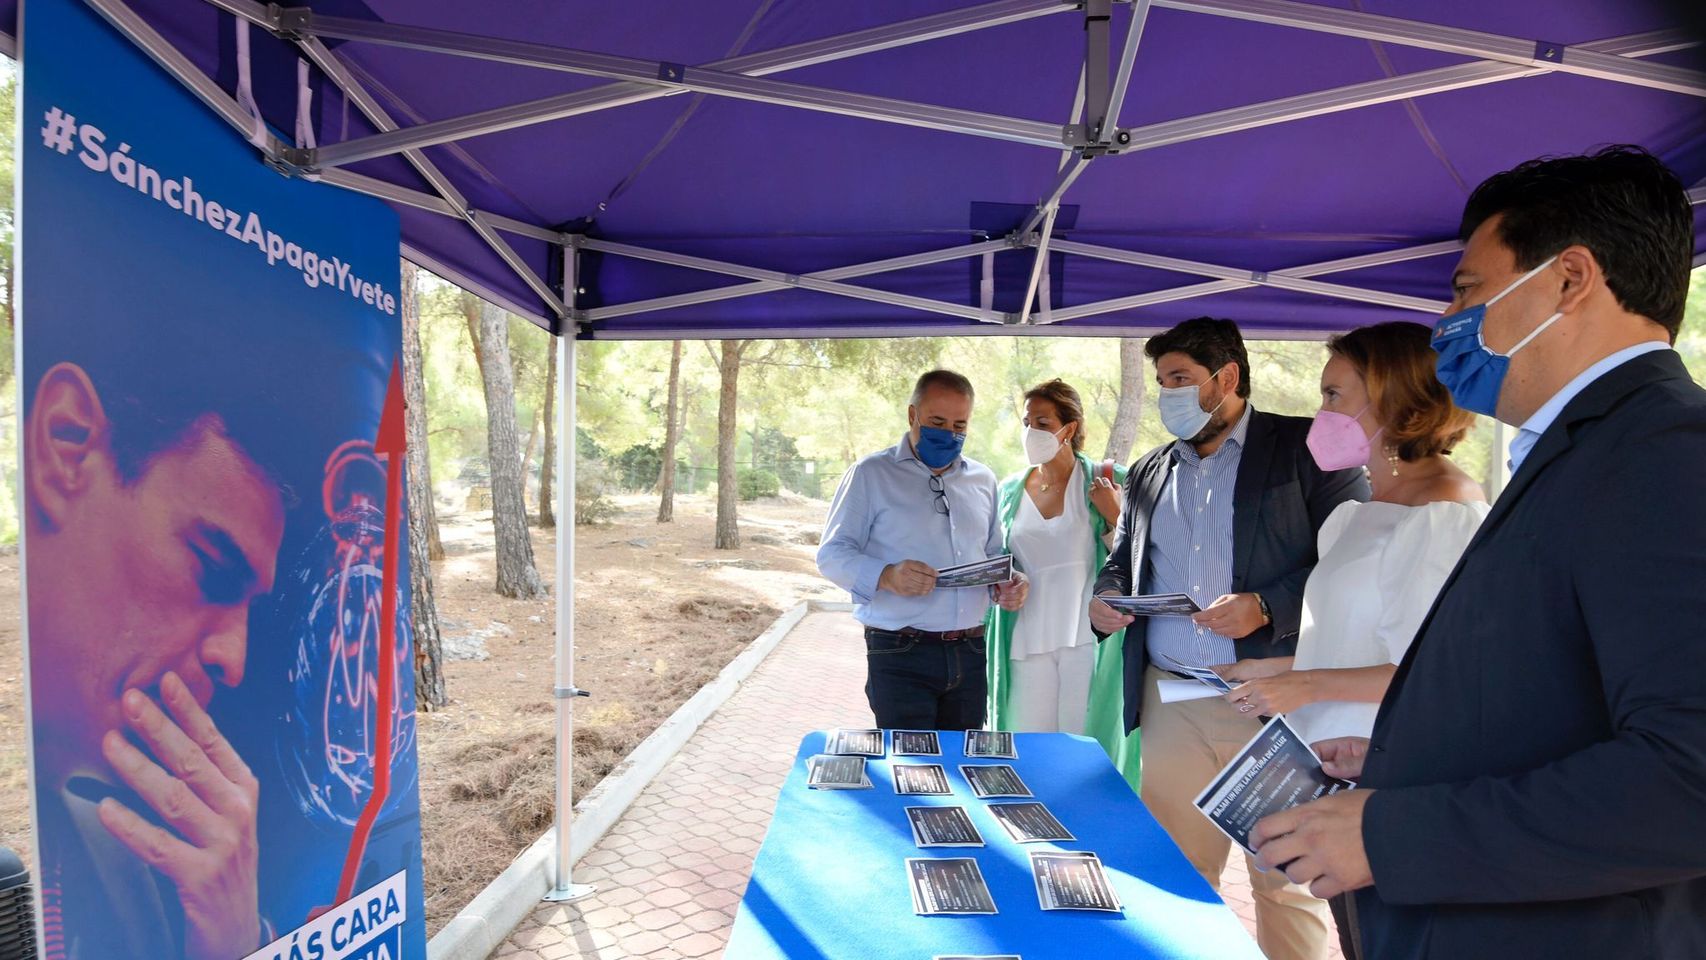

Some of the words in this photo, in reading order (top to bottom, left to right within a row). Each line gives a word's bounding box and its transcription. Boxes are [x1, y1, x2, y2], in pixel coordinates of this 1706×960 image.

[41, 106, 396, 315] #SánchezApagaYvete
[1212, 797, 1231, 817] BAJAR
[1246, 756, 1268, 779] FACTURA
[1275, 735, 1287, 747] LUZ
[330, 887, 401, 952] CARA
